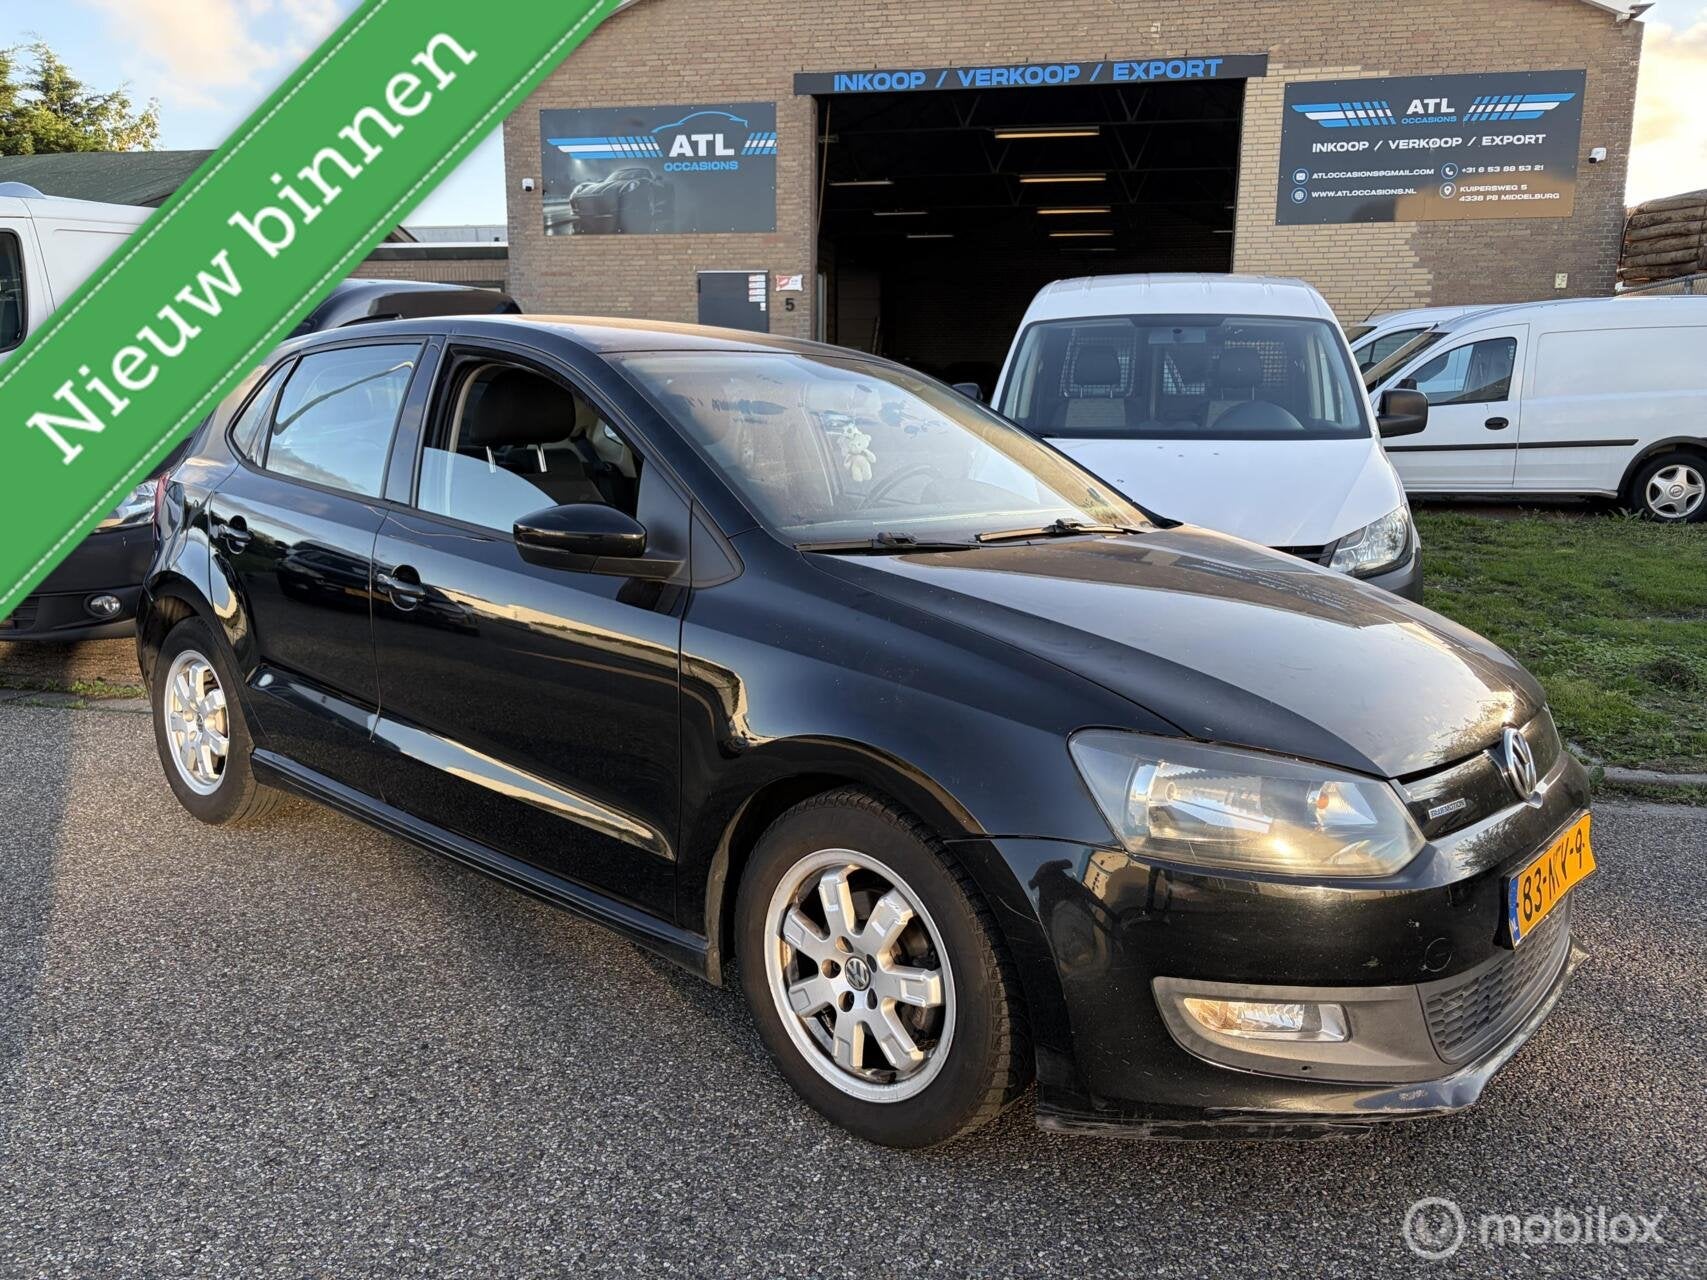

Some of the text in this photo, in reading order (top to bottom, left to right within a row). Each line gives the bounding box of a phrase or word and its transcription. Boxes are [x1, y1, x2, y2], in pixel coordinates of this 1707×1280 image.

[833, 58, 1224, 91] INKOOP / VERKOOP / EXPORT
[1406, 97, 1456, 116] ATL
[1401, 115, 1457, 125] OCCASIONS
[668, 133, 735, 158] ATL
[1312, 140, 1369, 153] INKOOP
[1388, 137, 1463, 150] VERKOOP
[1481, 133, 1547, 147] EXPORT
[663, 160, 739, 173] OCCASIONS
[1311, 188, 1417, 198] WWW.ATLOCCASIONS.NL
[1460, 184, 1518, 192] KUIPERSWEG
[1501, 192, 1560, 201] MIDDELBURG
[785, 297, 795, 312] 5
